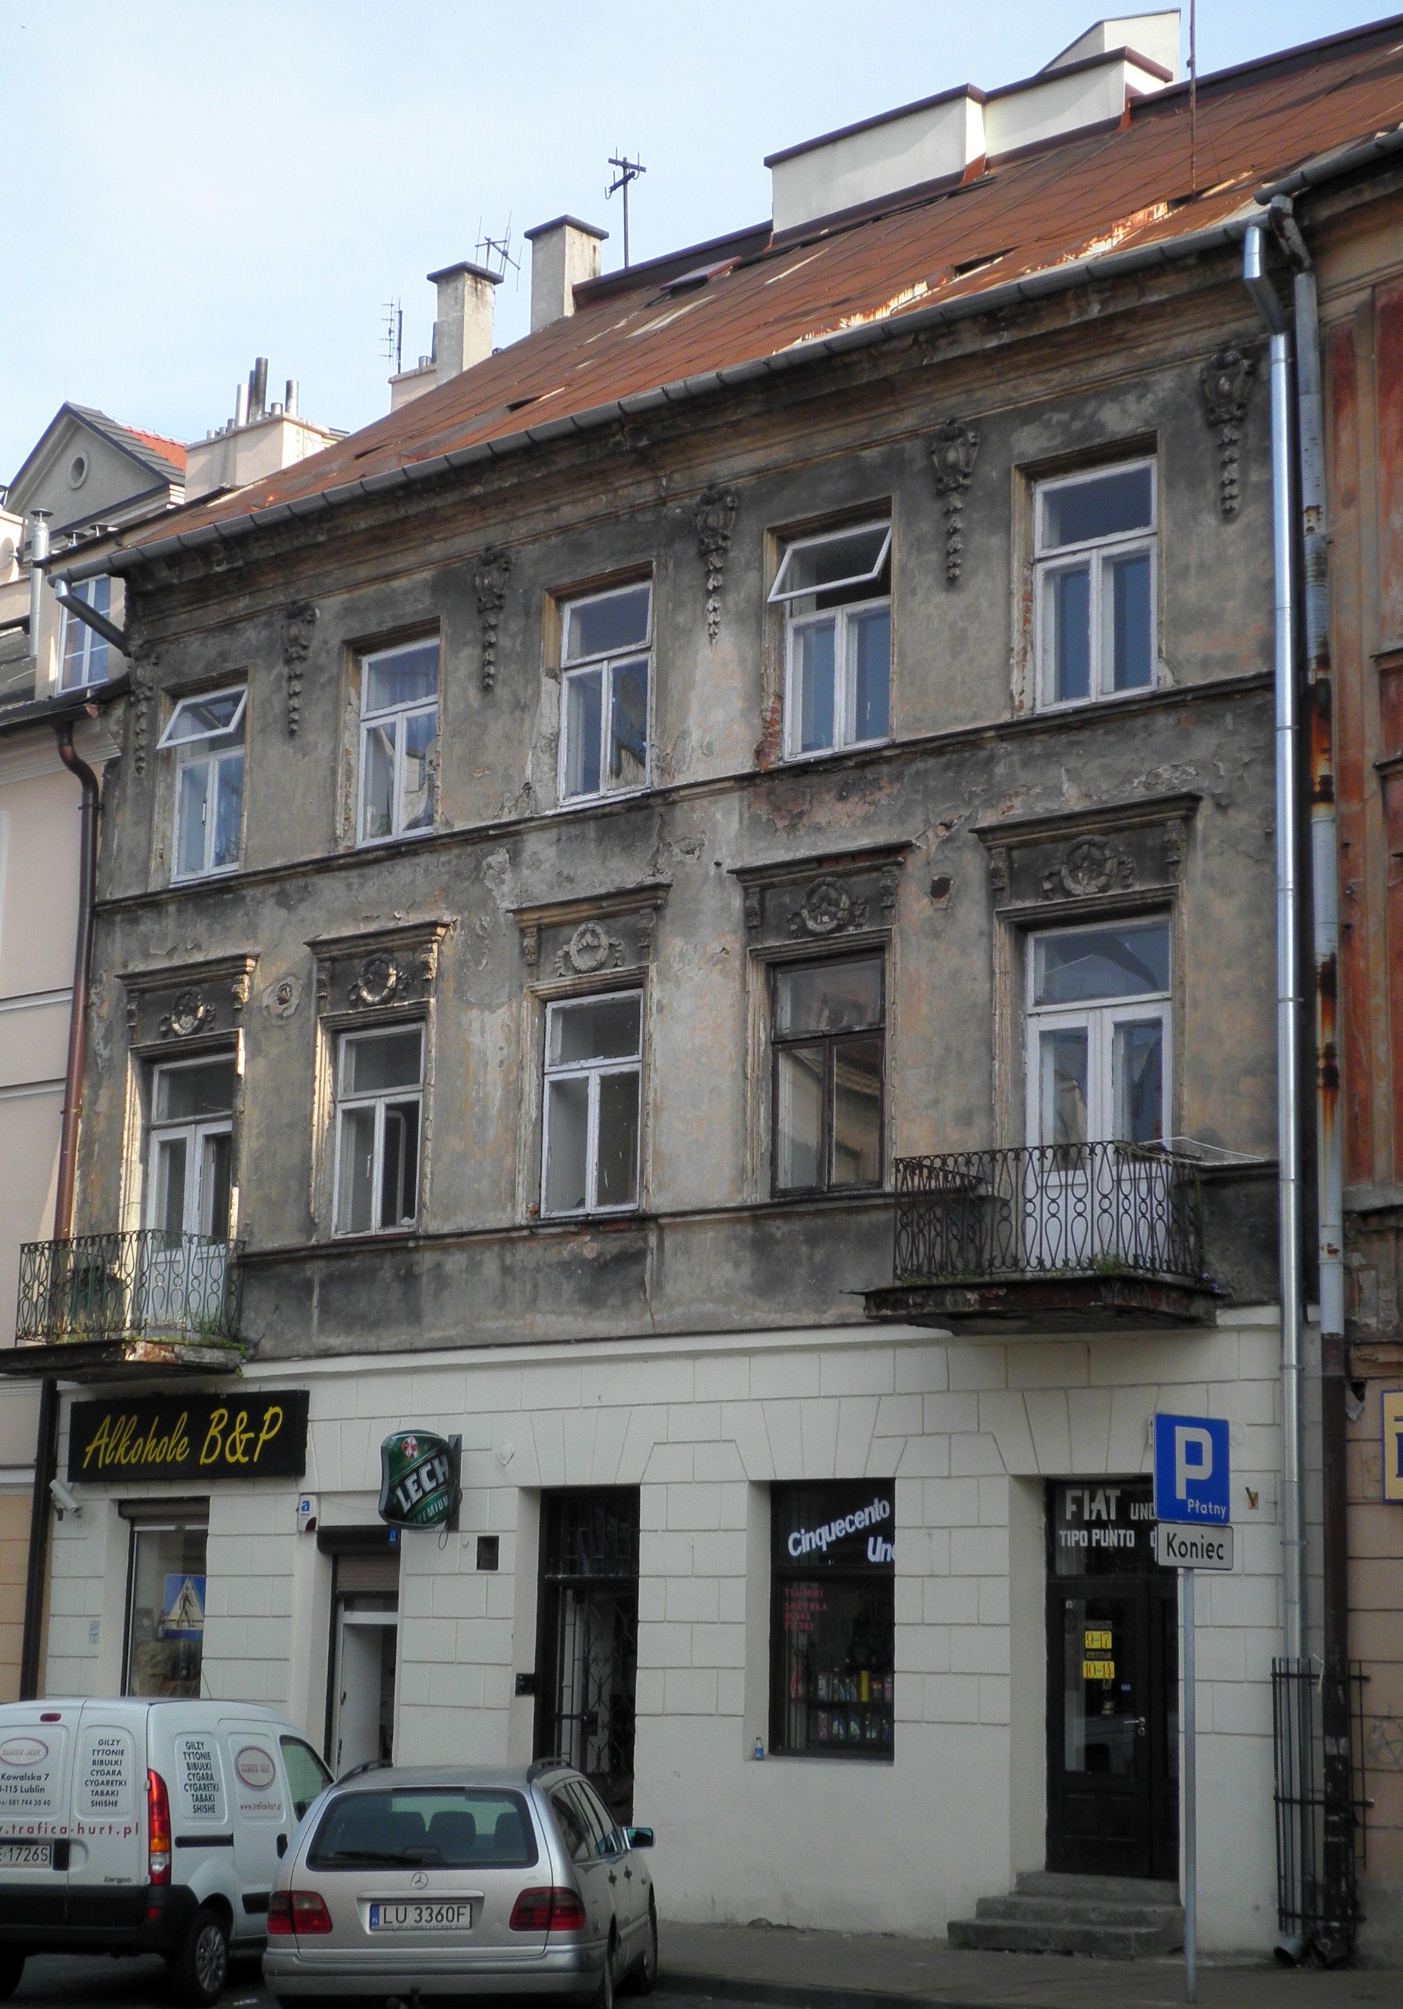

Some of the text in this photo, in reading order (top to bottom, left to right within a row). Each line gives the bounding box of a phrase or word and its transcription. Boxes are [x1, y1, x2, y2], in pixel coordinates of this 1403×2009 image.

[83, 1406, 283, 1468] Alkohole B&P
[1175, 1426, 1213, 1500] P
[395, 1454, 449, 1514] LECH
[1065, 1489, 1121, 1521] FIAT
[1187, 1499, 1227, 1520] Płatny
[788, 1497, 890, 1557] Cinquecento
[1059, 1529, 1088, 1548] TIPO
[1091, 1528, 1135, 1548] PUNTO
[1166, 1532, 1224, 1561] Koniec
[1086, 1633, 1109, 1648] 9-17
[1085, 1663, 1112, 1679] 10-14
[185, 1741, 204, 1750] GILZY
[183, 1752, 211, 1761] TYTONIE
[1, 1773, 50, 1781] Kowalska 7
[90, 1769, 122, 1777] CYGARA
[187, 1772, 214, 1782] CYGARA
[20, 1785, 45, 1794] Lublin
[84, 1779, 127, 1787] CYGARETKI
[184, 1783, 219, 1793] CYGARETKI
[90, 1800, 118, 1808] SHISHE
[191, 1793, 215, 1803] TABAKI
[192, 1804, 216, 1814] SHISHE
[9, 1848, 49, 1862] 1726S
[383, 1906, 467, 1925] LU 3360F
